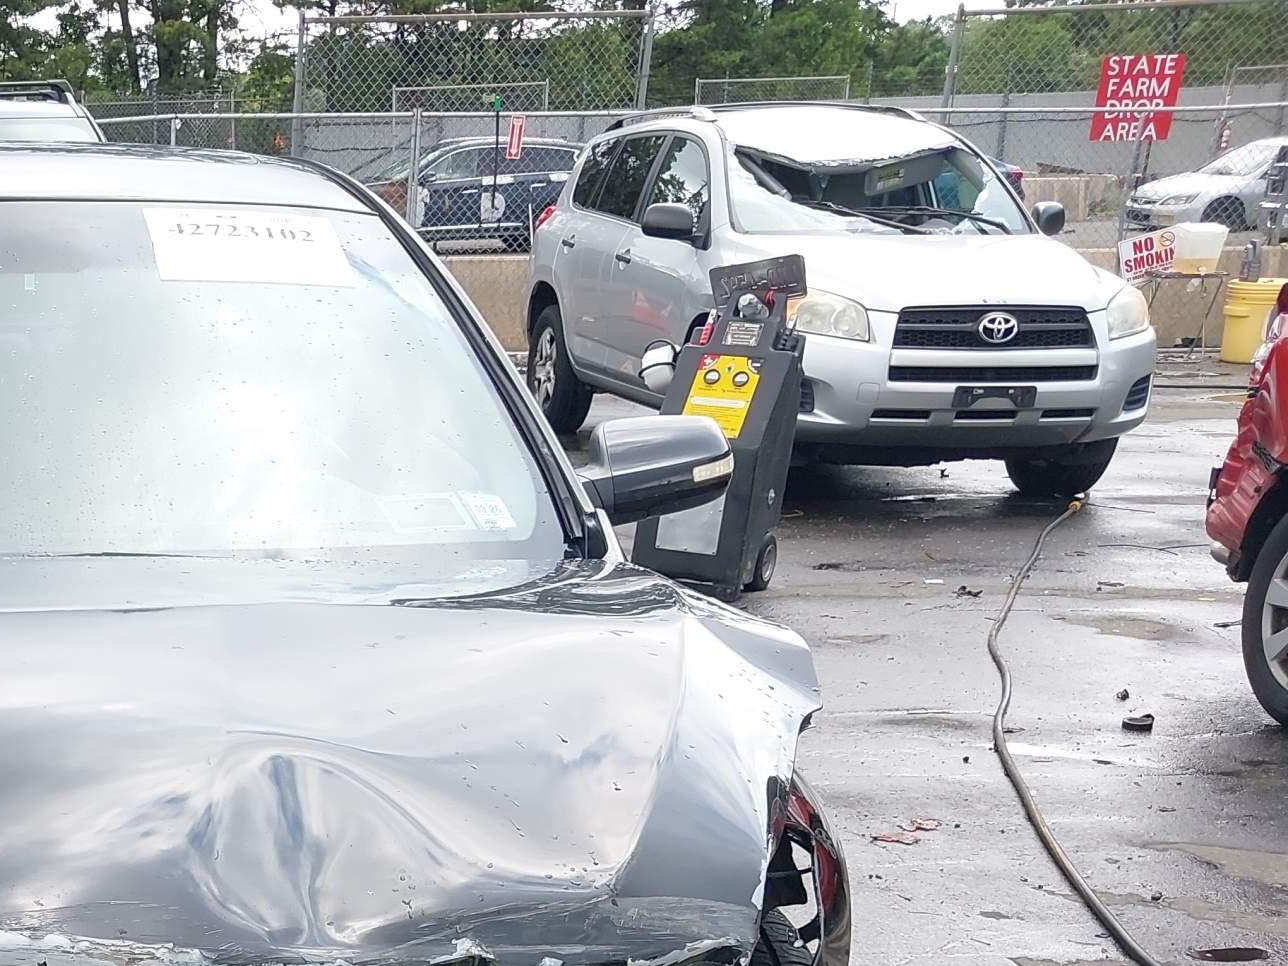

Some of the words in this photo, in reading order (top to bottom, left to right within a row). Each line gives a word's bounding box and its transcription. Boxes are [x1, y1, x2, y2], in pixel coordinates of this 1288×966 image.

[1107, 54, 1179, 76] STATE
[1106, 77, 1172, 98] FARM
[1104, 99, 1165, 119] DROP
[1099, 122, 1158, 142] AREA
[1132, 236, 1155, 256] NO
[1124, 246, 1175, 274] SMOKIN
